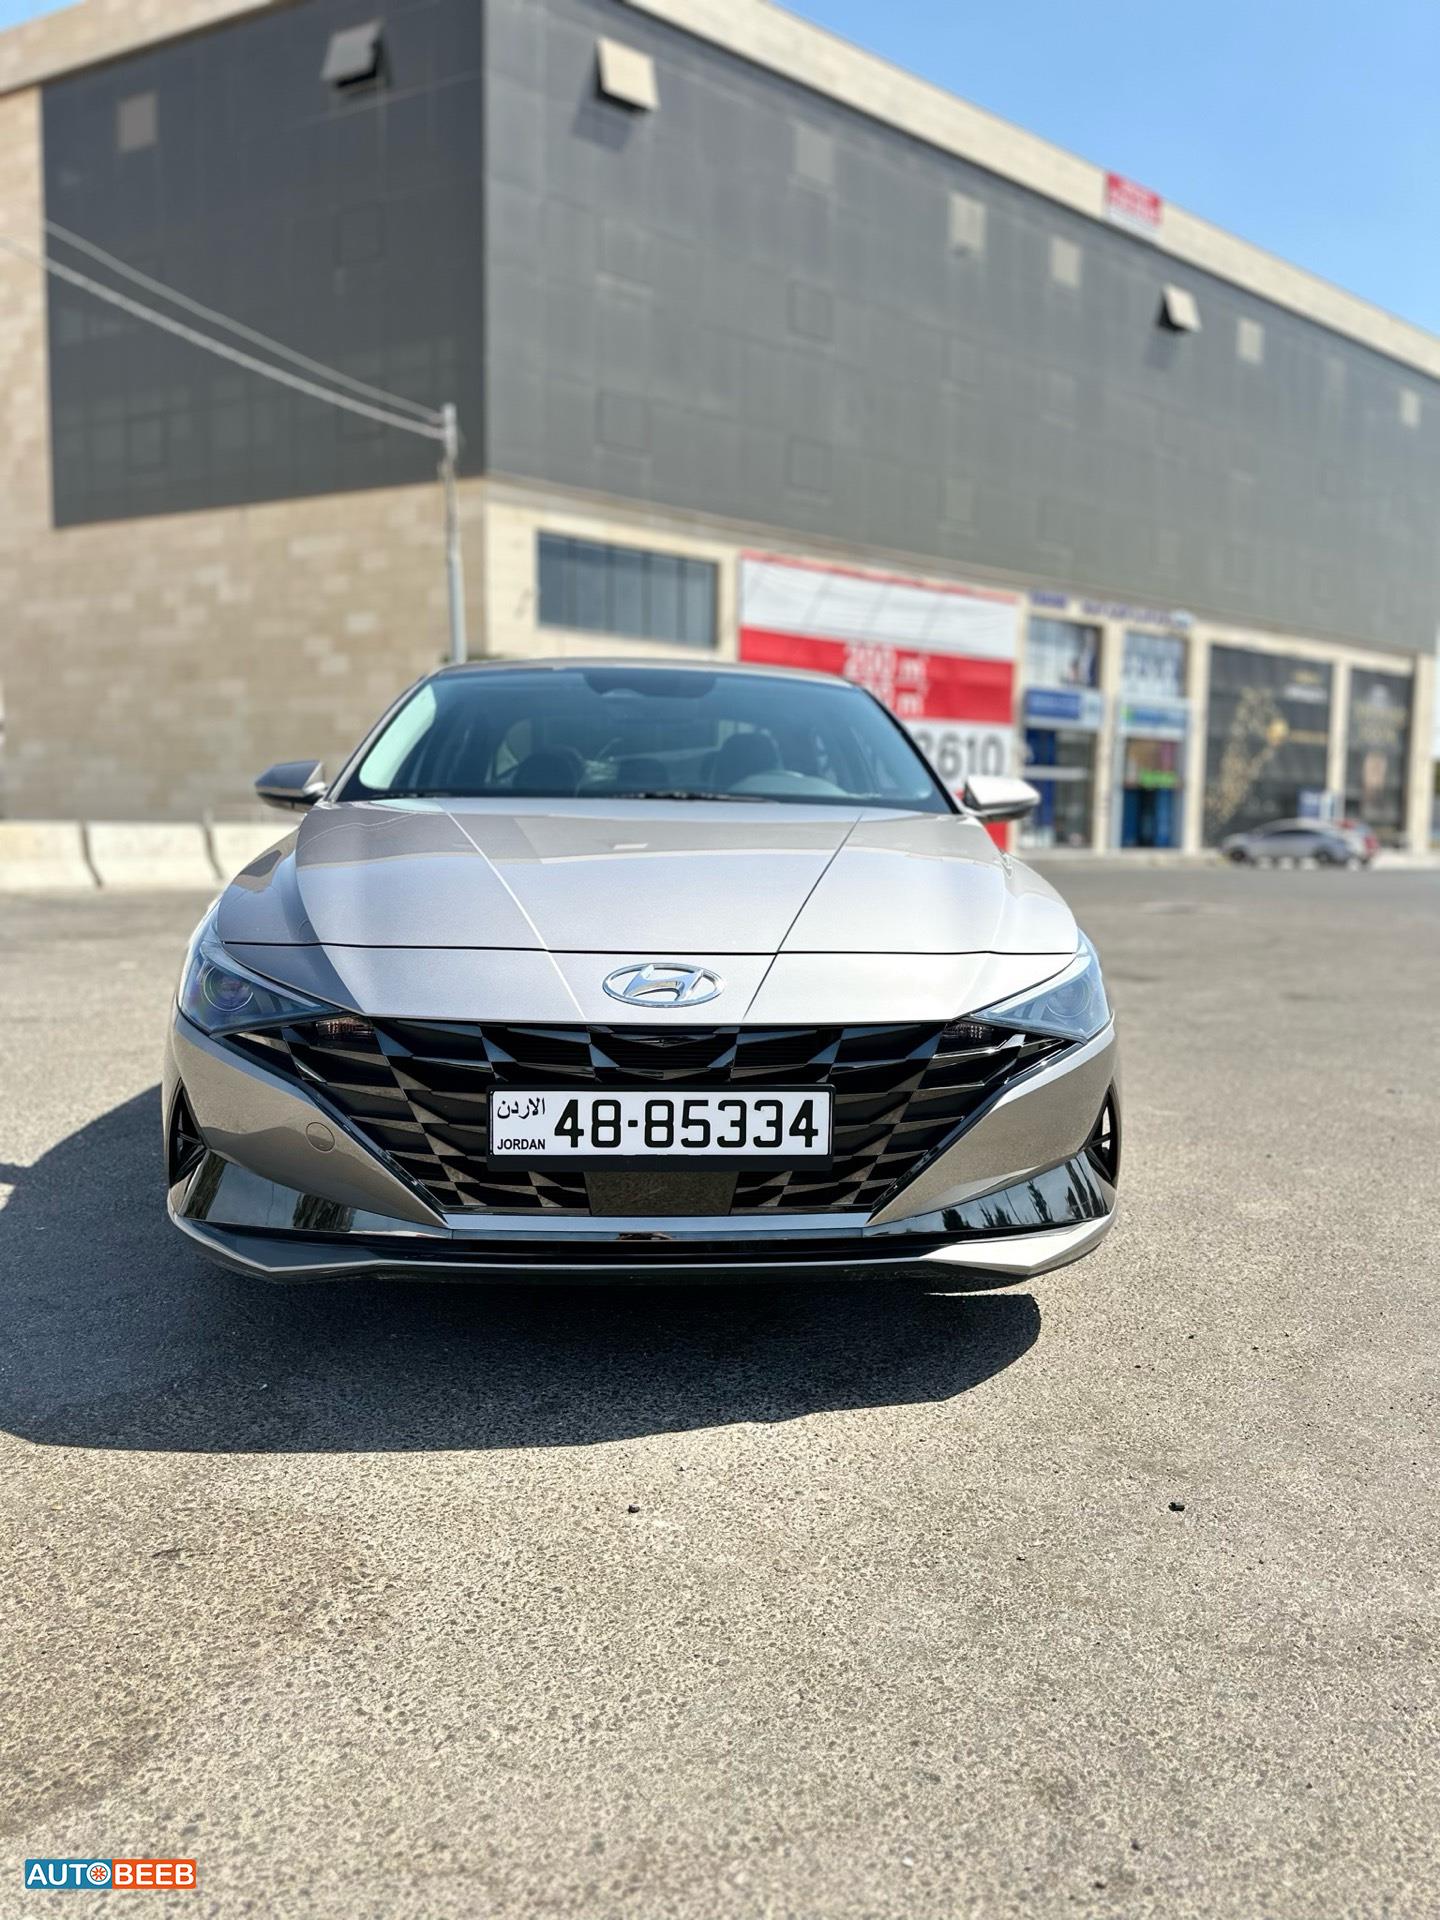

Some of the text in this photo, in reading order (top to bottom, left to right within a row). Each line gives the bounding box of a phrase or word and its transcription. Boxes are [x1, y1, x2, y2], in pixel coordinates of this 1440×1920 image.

[497, 1097, 546, 1119] الاردن
[554, 1099, 819, 1148] 48-85334
[497, 1138, 546, 1151] JORDAN
